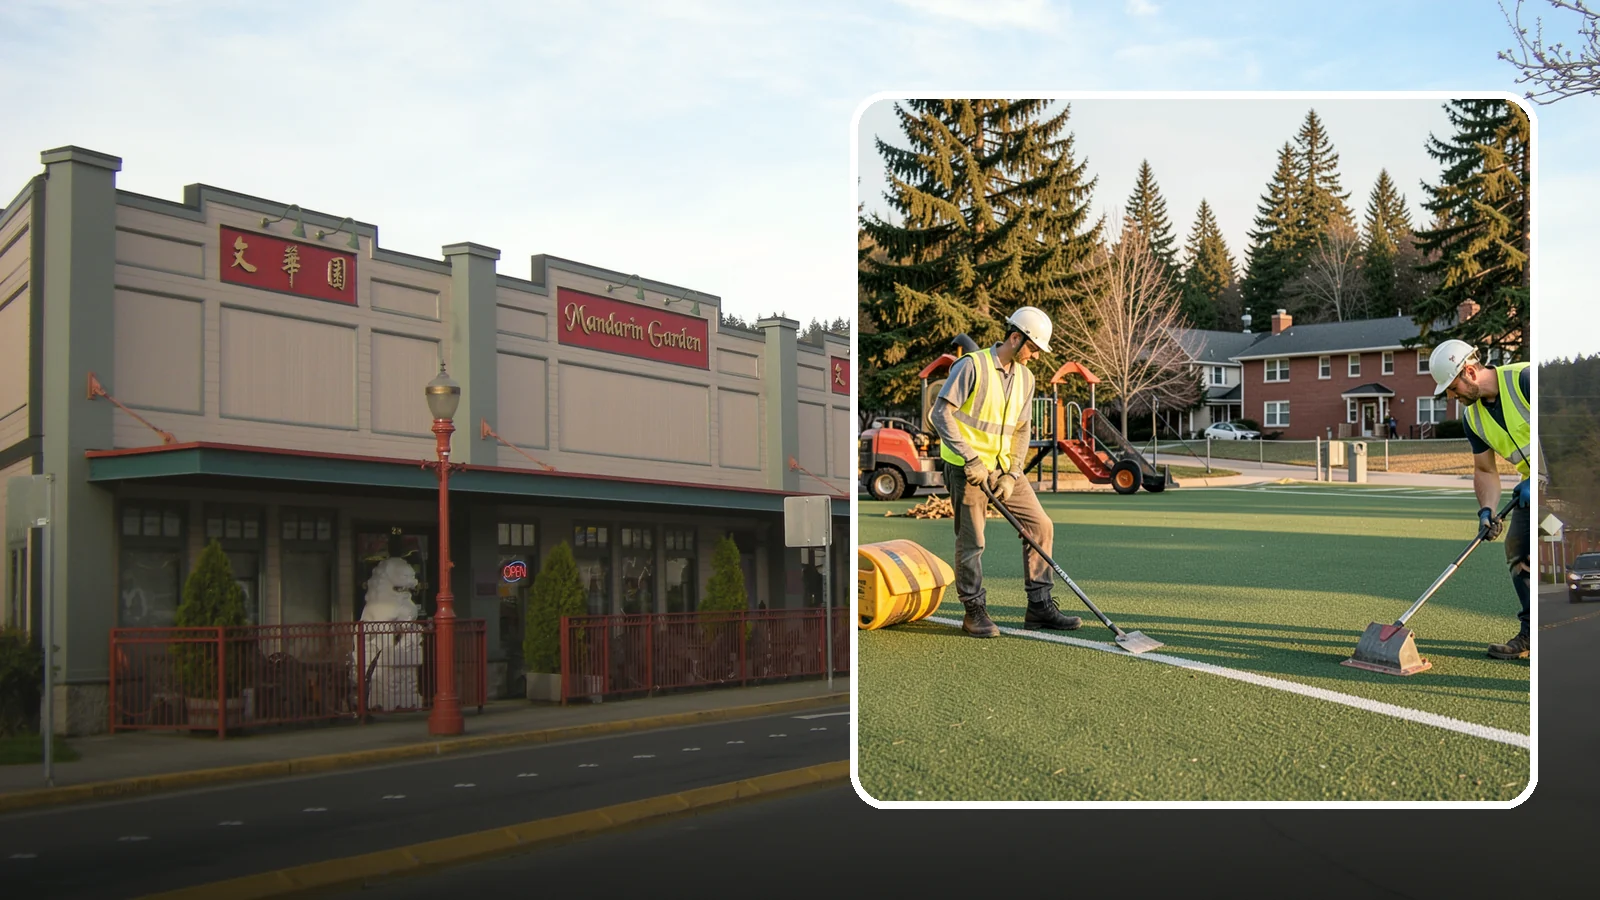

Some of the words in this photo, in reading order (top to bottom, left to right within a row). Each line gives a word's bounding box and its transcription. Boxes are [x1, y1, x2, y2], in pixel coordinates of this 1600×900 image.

[231, 235, 347, 290] 文華園
[564, 302, 644, 341] Mandarin
[647, 320, 702, 352] Garden
[503, 565, 527, 578] OPEN
